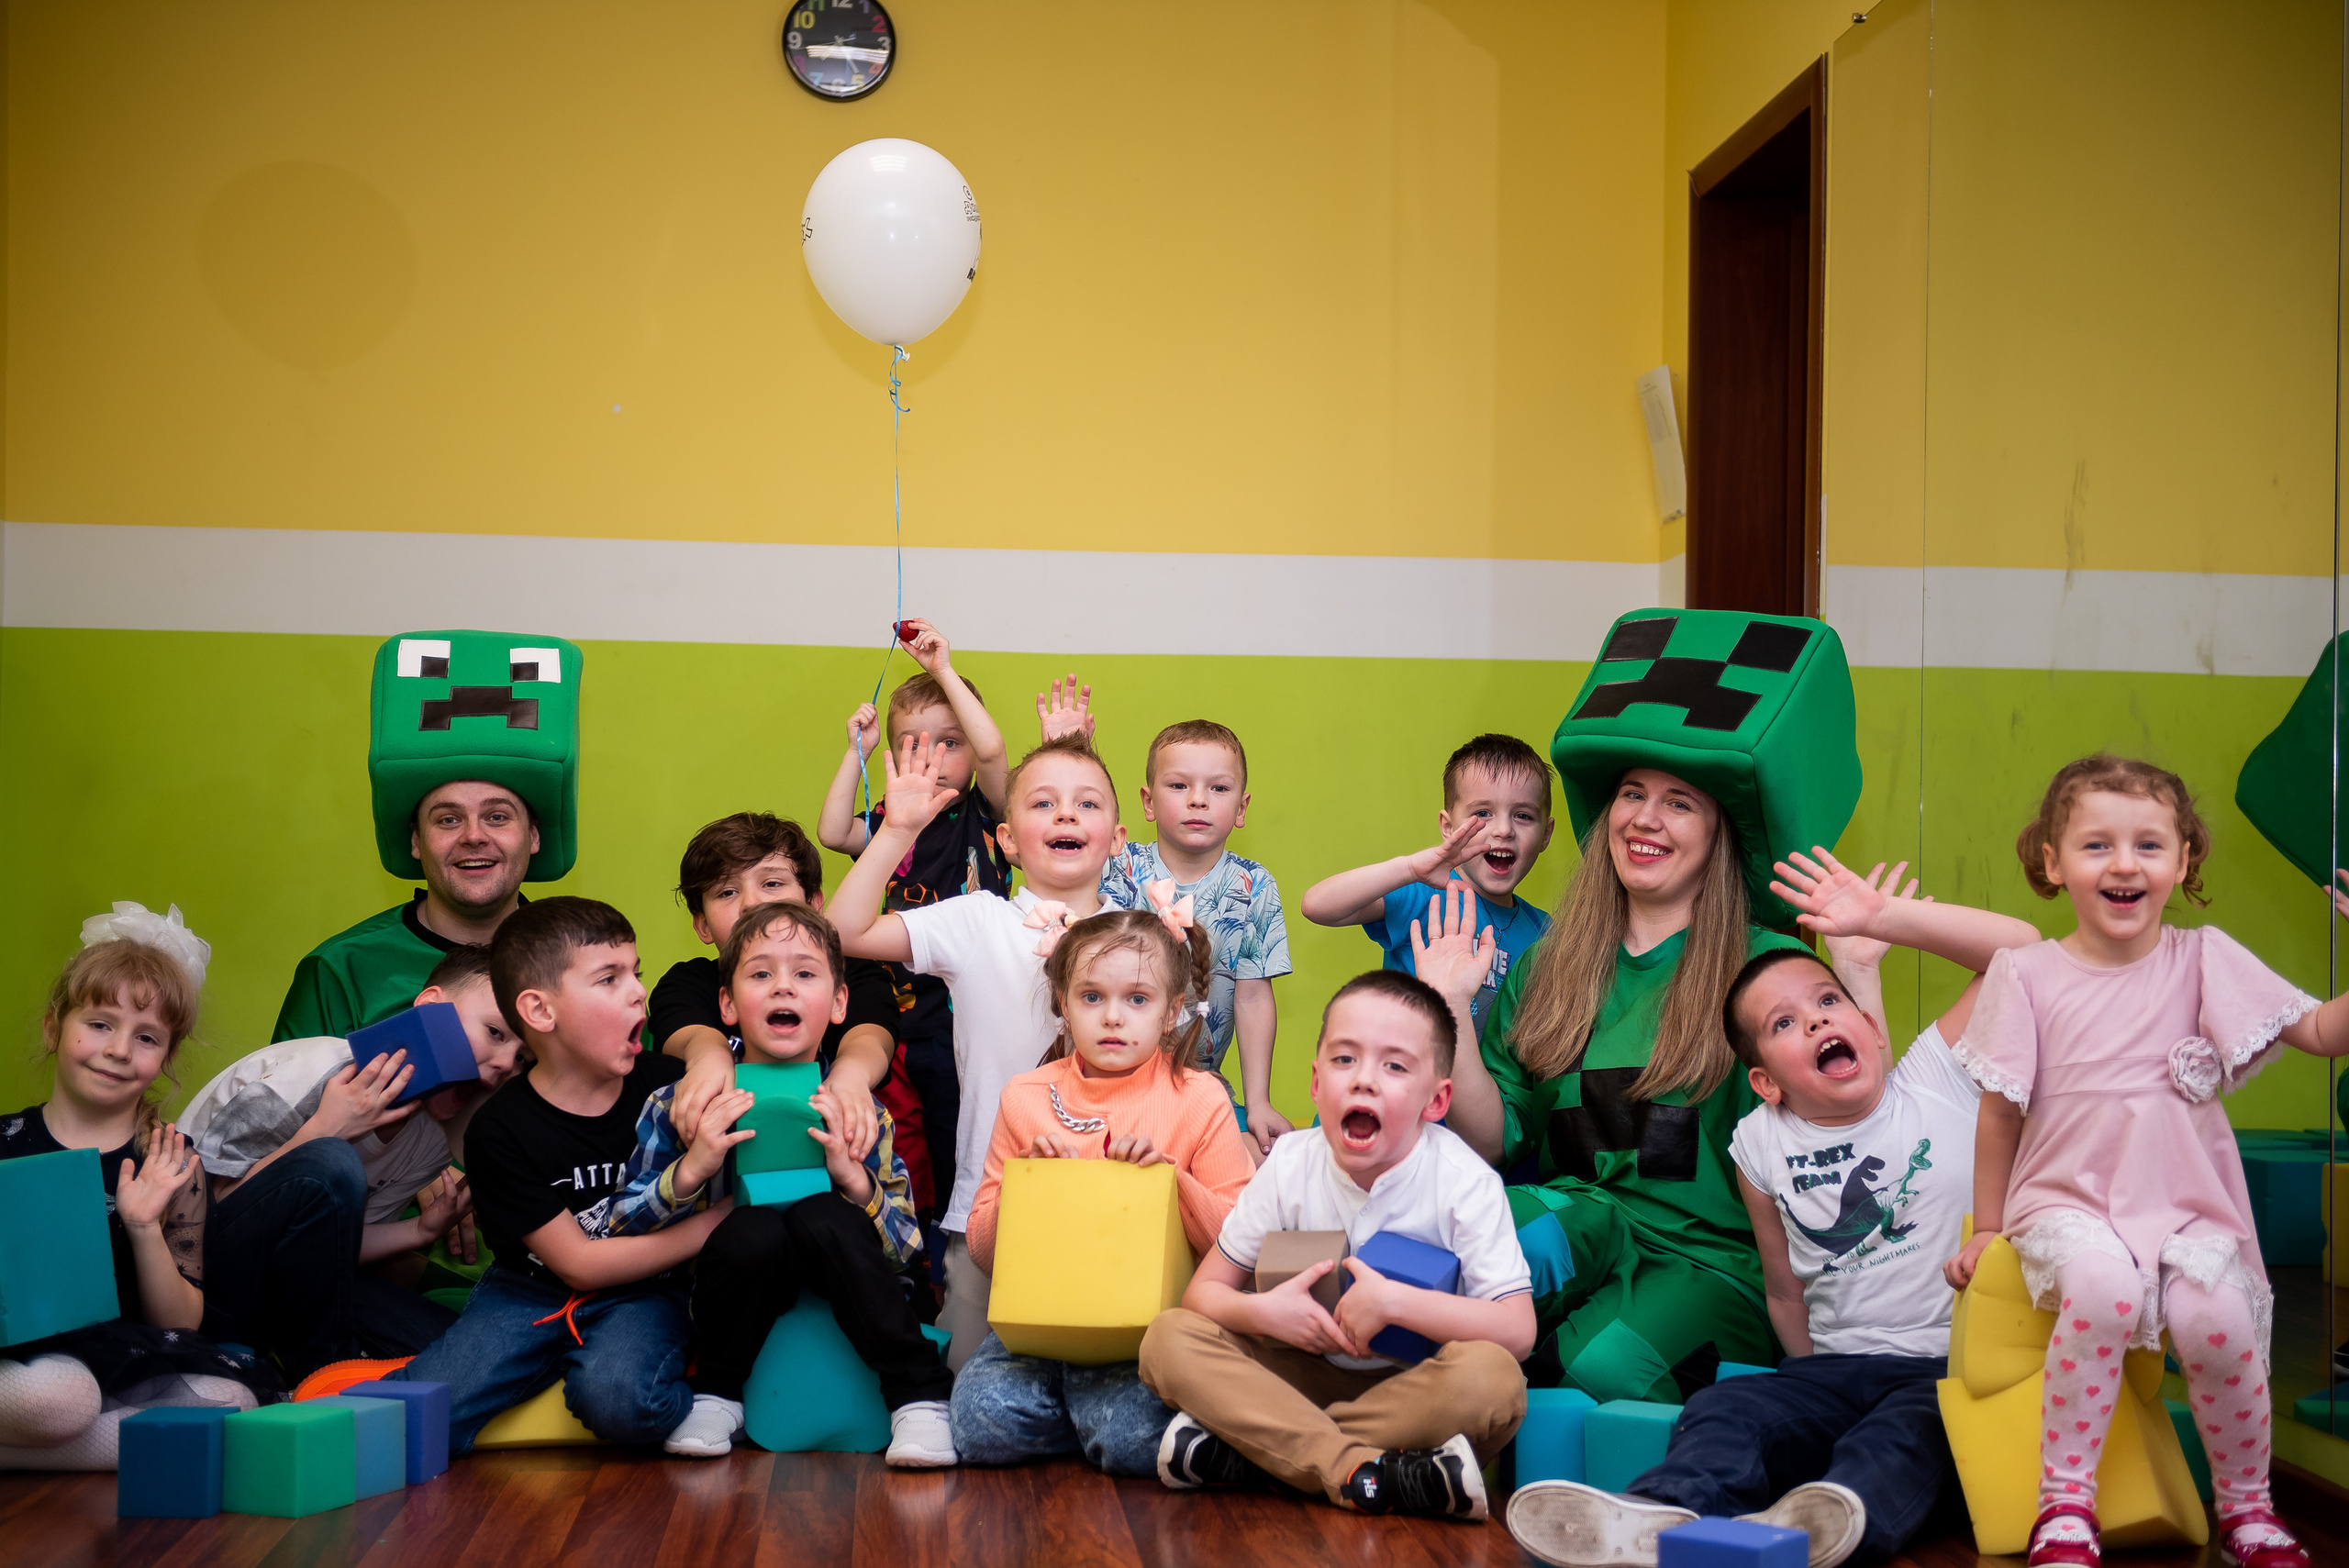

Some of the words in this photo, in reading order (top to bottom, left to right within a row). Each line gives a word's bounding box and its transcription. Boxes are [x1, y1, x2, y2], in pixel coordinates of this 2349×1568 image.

[793, 11, 816, 28] 10
[872, 15, 886, 33] 2
[787, 31, 803, 50] 9
[876, 36, 891, 52] 3
[808, 72, 824, 86] 7
[851, 74, 865, 87] 5
[1792, 1170, 1842, 1194] TEAM
[1840, 1262, 1865, 1274] YOUR
